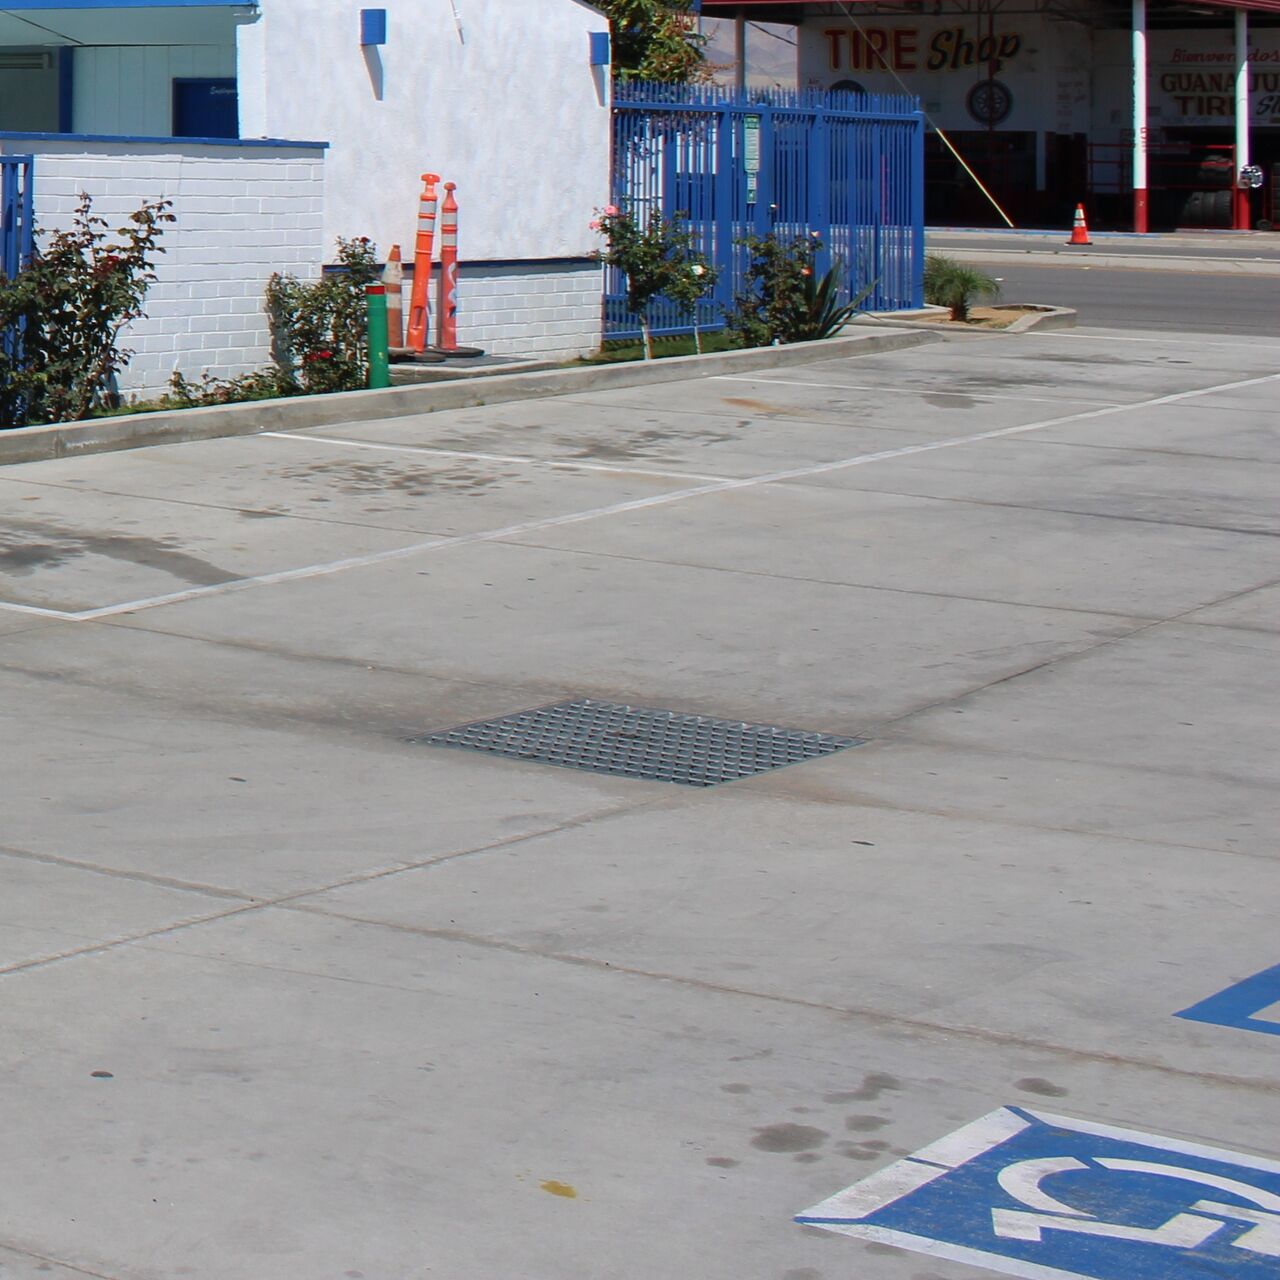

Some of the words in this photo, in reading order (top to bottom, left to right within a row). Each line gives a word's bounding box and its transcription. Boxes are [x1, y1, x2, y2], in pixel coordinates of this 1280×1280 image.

[823, 26, 921, 72] TIRE
[926, 26, 1023, 73] Shop
[1170, 47, 1280, 63] Bienvendos
[1172, 95, 1237, 116] TIR
